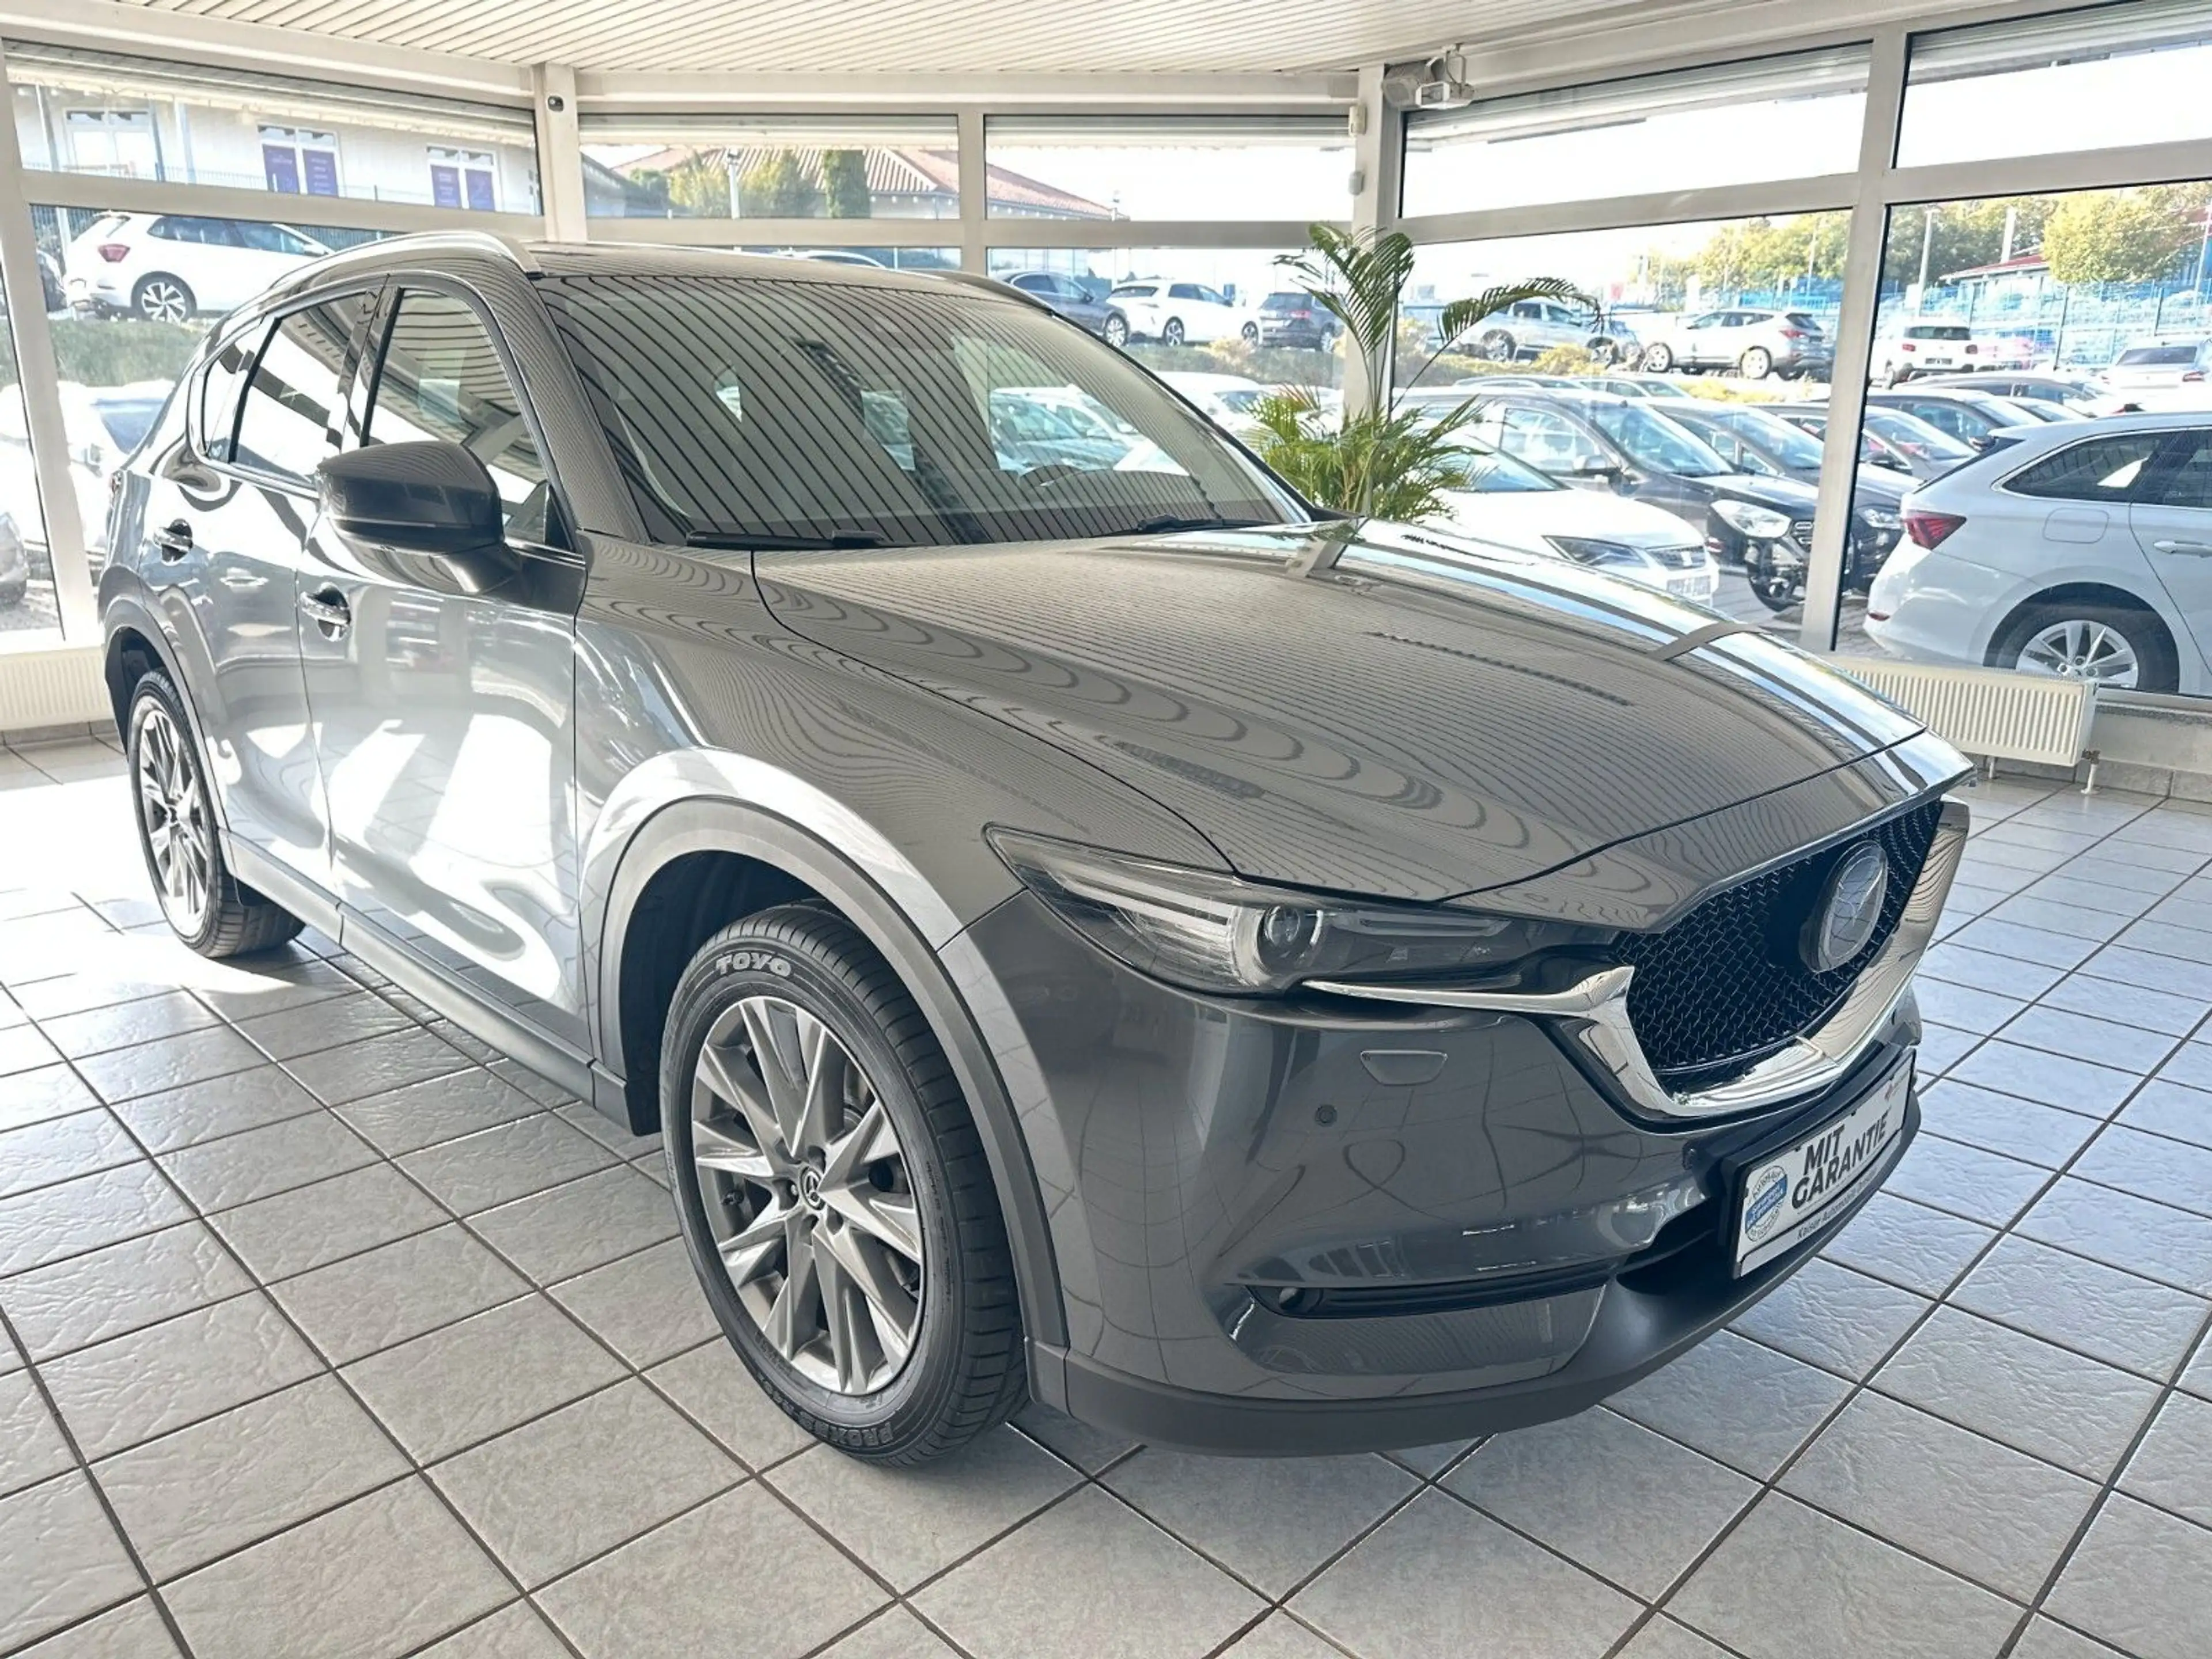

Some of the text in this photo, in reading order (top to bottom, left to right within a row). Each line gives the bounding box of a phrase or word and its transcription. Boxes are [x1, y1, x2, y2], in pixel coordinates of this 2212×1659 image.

[715, 952, 791, 978] TOYO
[1792, 1111, 1888, 1209] GARANTIE
[1804, 1124, 1845, 1176] MIT
